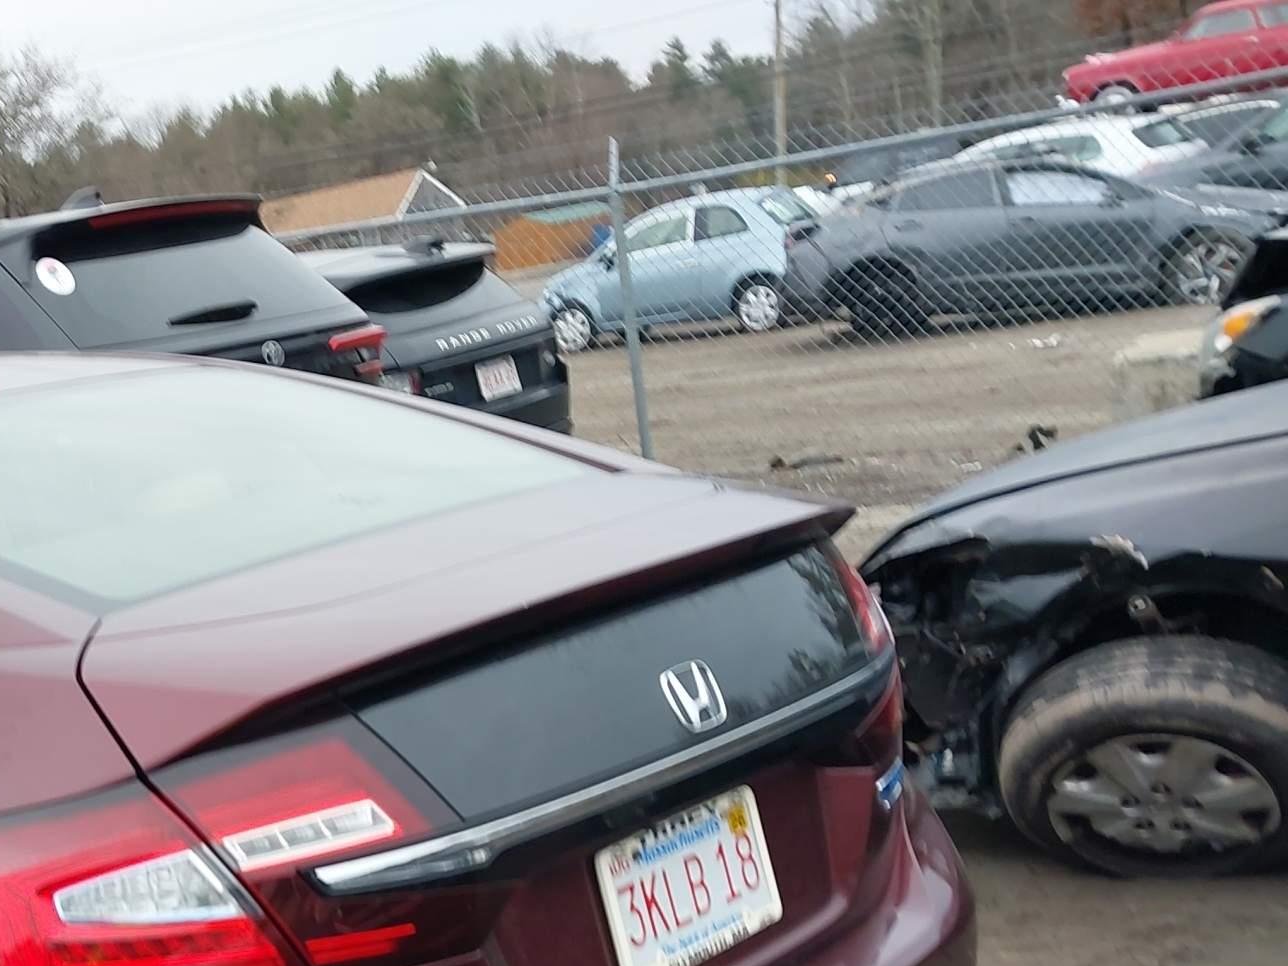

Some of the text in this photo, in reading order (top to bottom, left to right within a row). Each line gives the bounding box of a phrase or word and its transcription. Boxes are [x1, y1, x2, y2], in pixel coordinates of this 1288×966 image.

[496, 315, 537, 335] ROVER
[615, 852, 711, 947] 3KLB
[716, 832, 760, 904] 18
